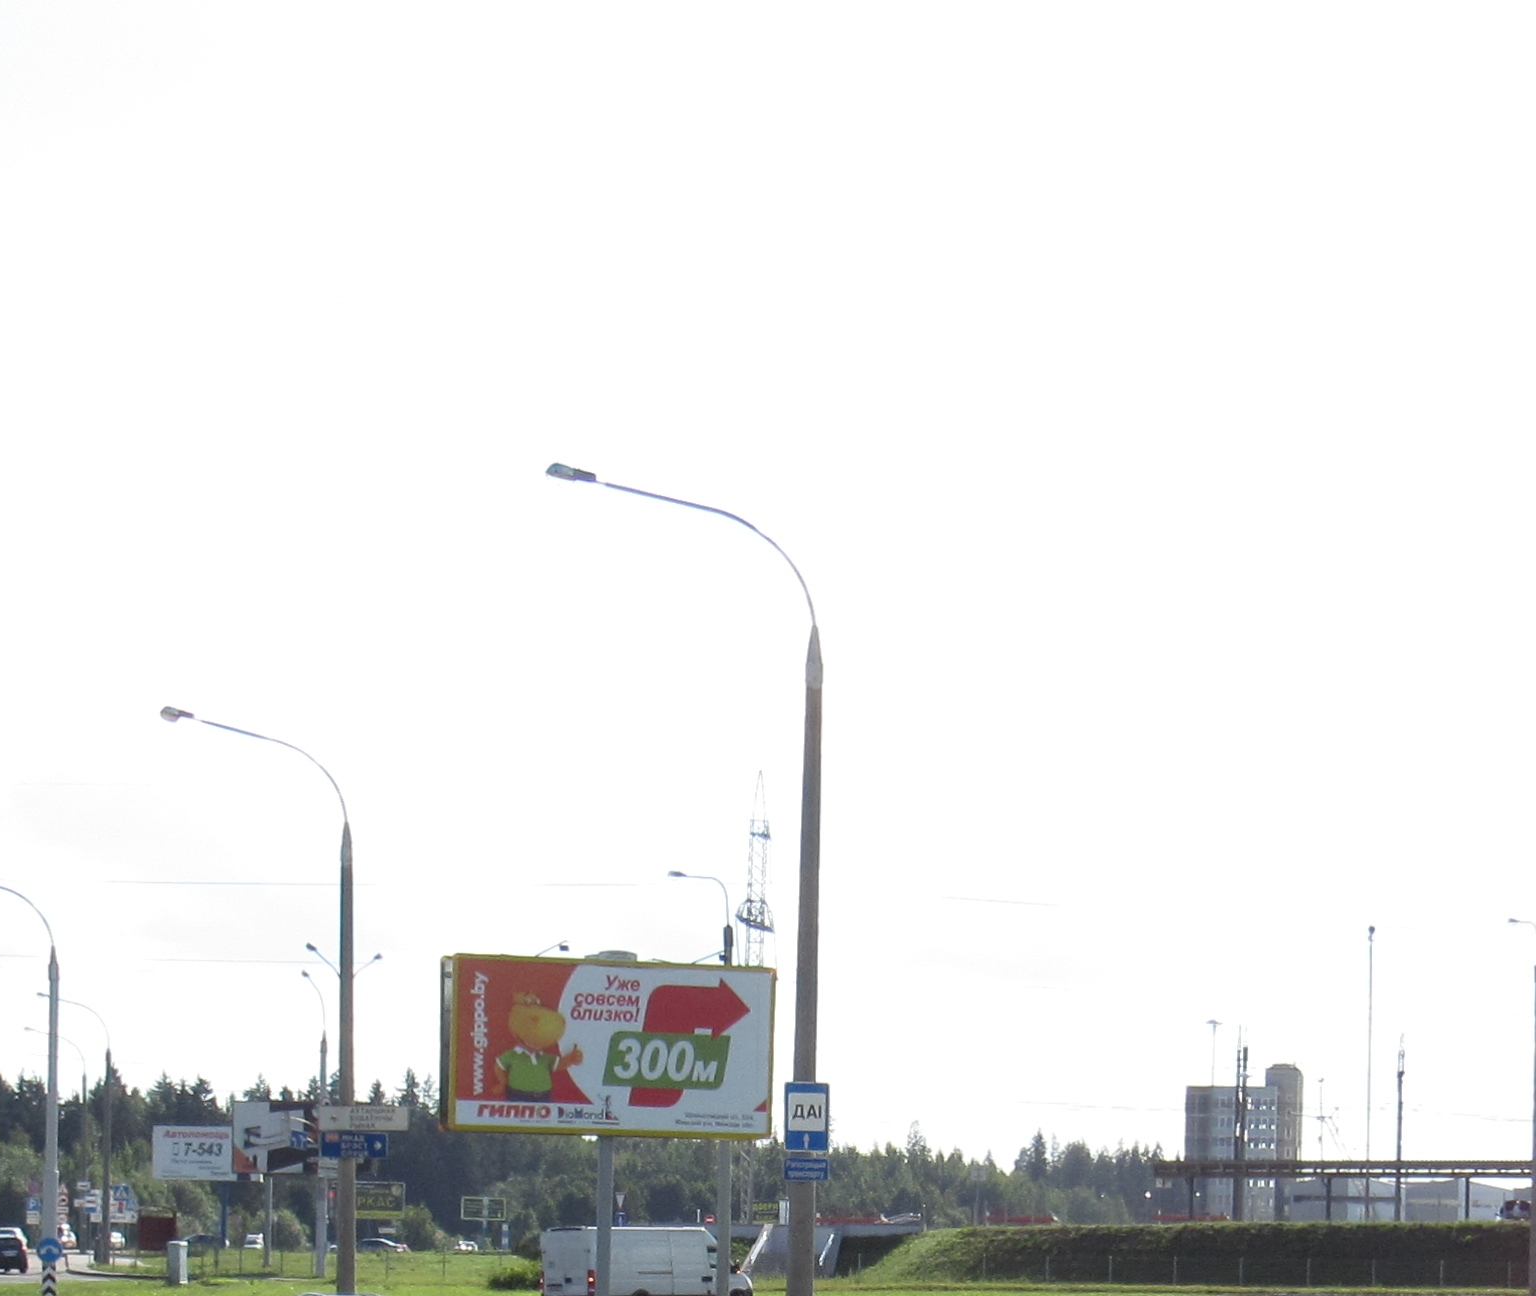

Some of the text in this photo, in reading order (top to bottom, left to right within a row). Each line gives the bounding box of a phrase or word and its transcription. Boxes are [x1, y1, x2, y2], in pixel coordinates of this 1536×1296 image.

[605, 975, 640, 992] Уже
[574, 993, 640, 1008] совсем
[570, 1005, 640, 1023] близко!
[470, 971, 489, 1096] www.gippo.by
[614, 1037, 718, 1083] 300м
[477, 1104, 552, 1119] ГИППО
[792, 1104, 822, 1121] ДАІ
[184, 1142, 223, 1157] 7-543
